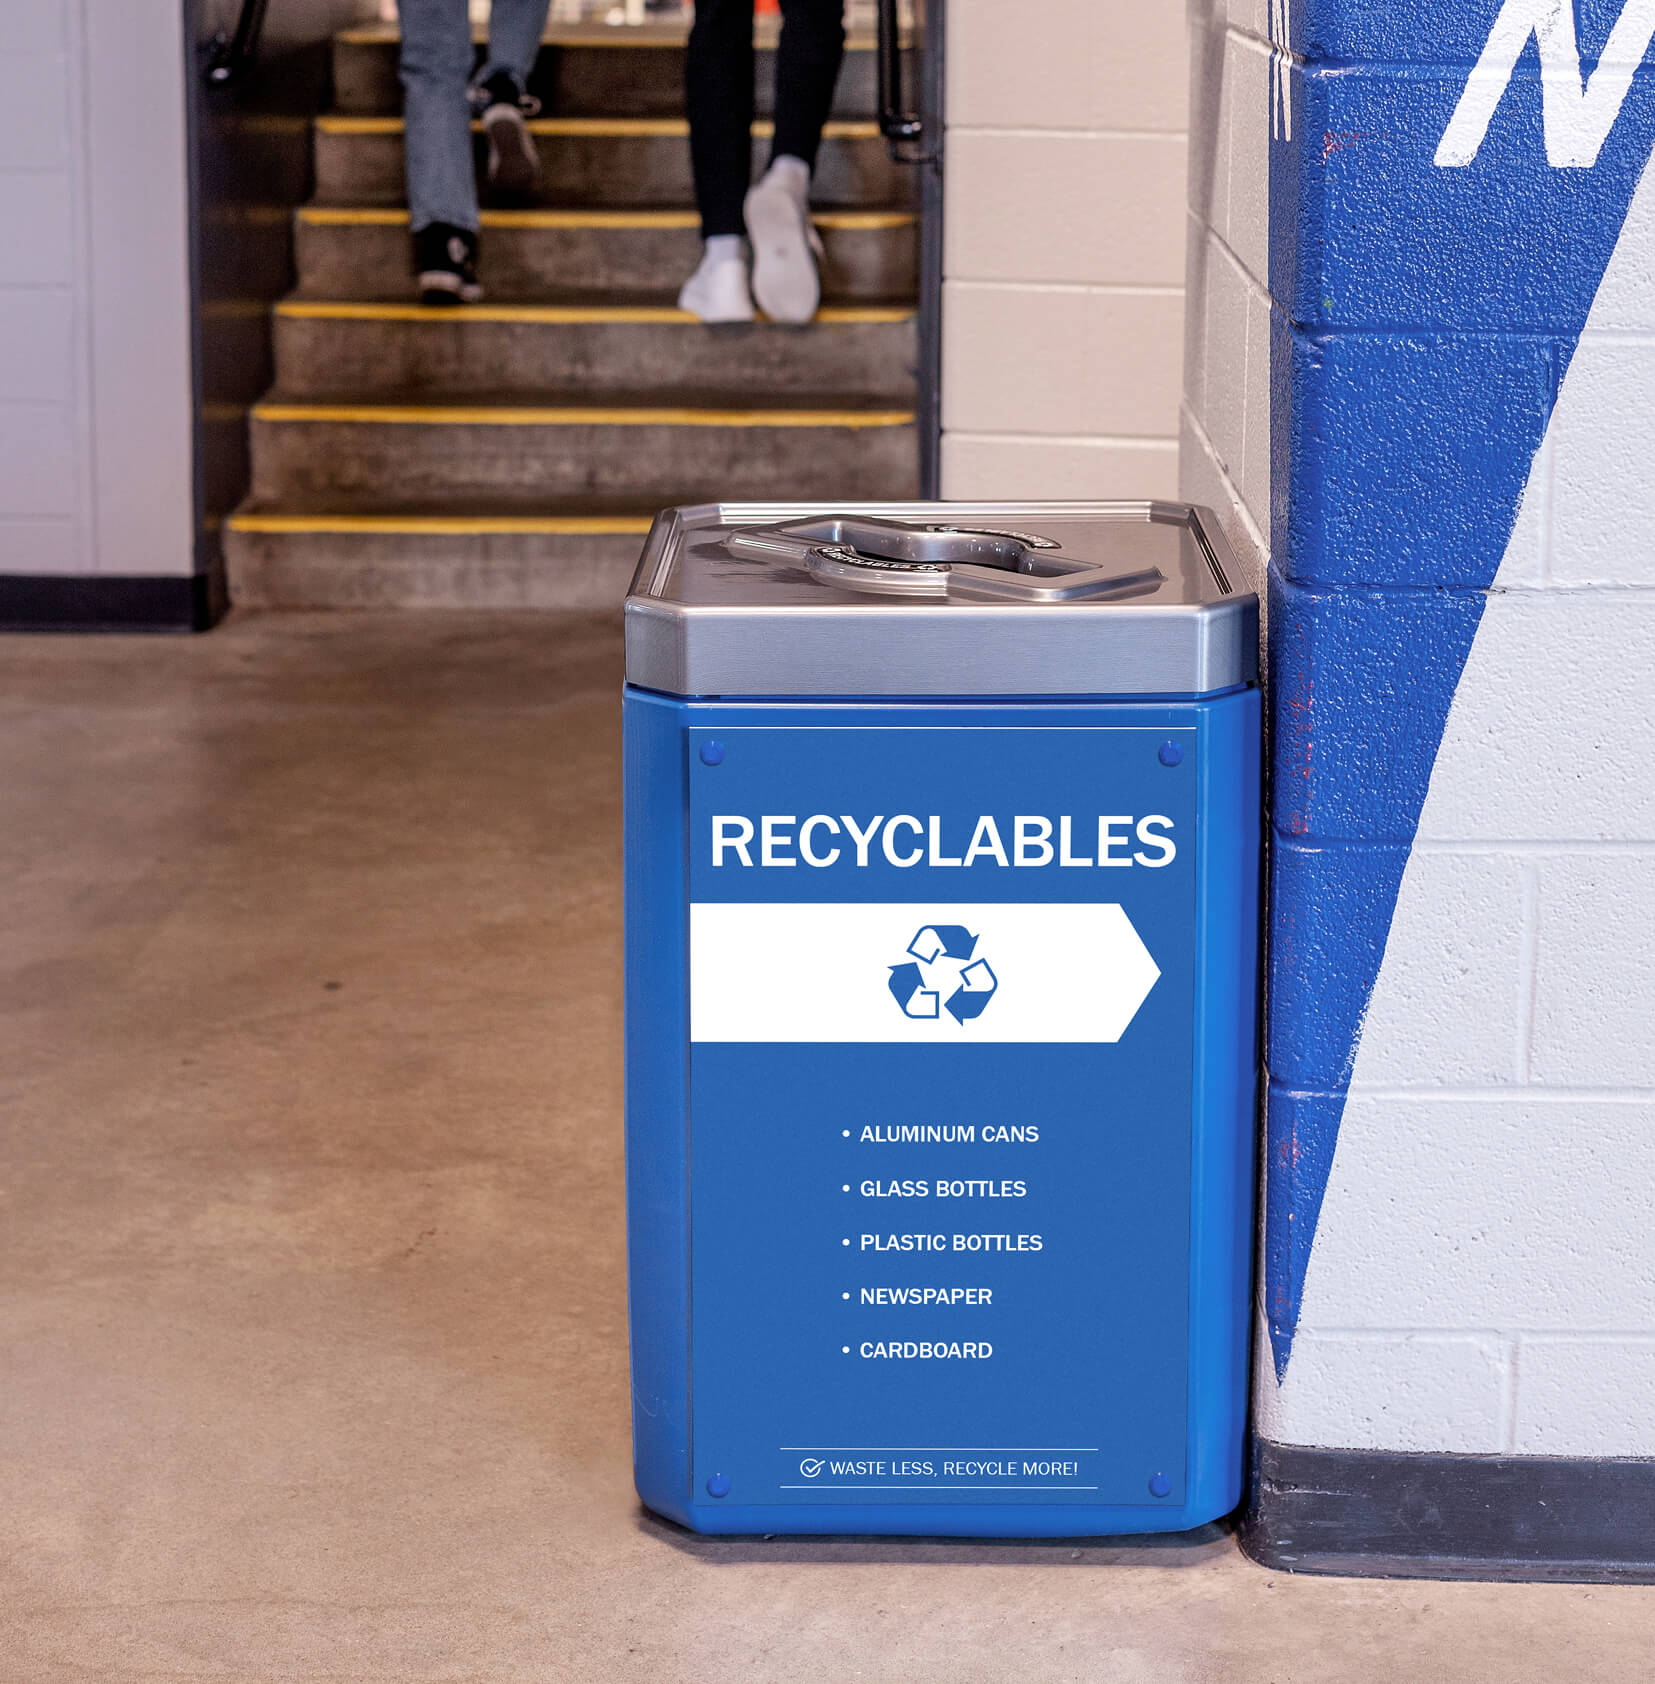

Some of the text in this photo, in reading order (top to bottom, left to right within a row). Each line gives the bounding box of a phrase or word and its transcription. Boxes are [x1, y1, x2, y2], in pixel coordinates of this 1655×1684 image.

[712, 815, 1177, 868] RECYCLABLES
[860, 1125, 1040, 1143] ALUMINUM CANS
[860, 1180, 1027, 1198] GLASS BOTTLES
[860, 1234, 1043, 1252] PLASTIC BOTTLES
[860, 1288, 993, 1305] NEWSPAPER
[859, 1341, 993, 1359] CARDBOARD
[829, 1461, 1078, 1478] WASTE LESS, RECYCLE MORE!
